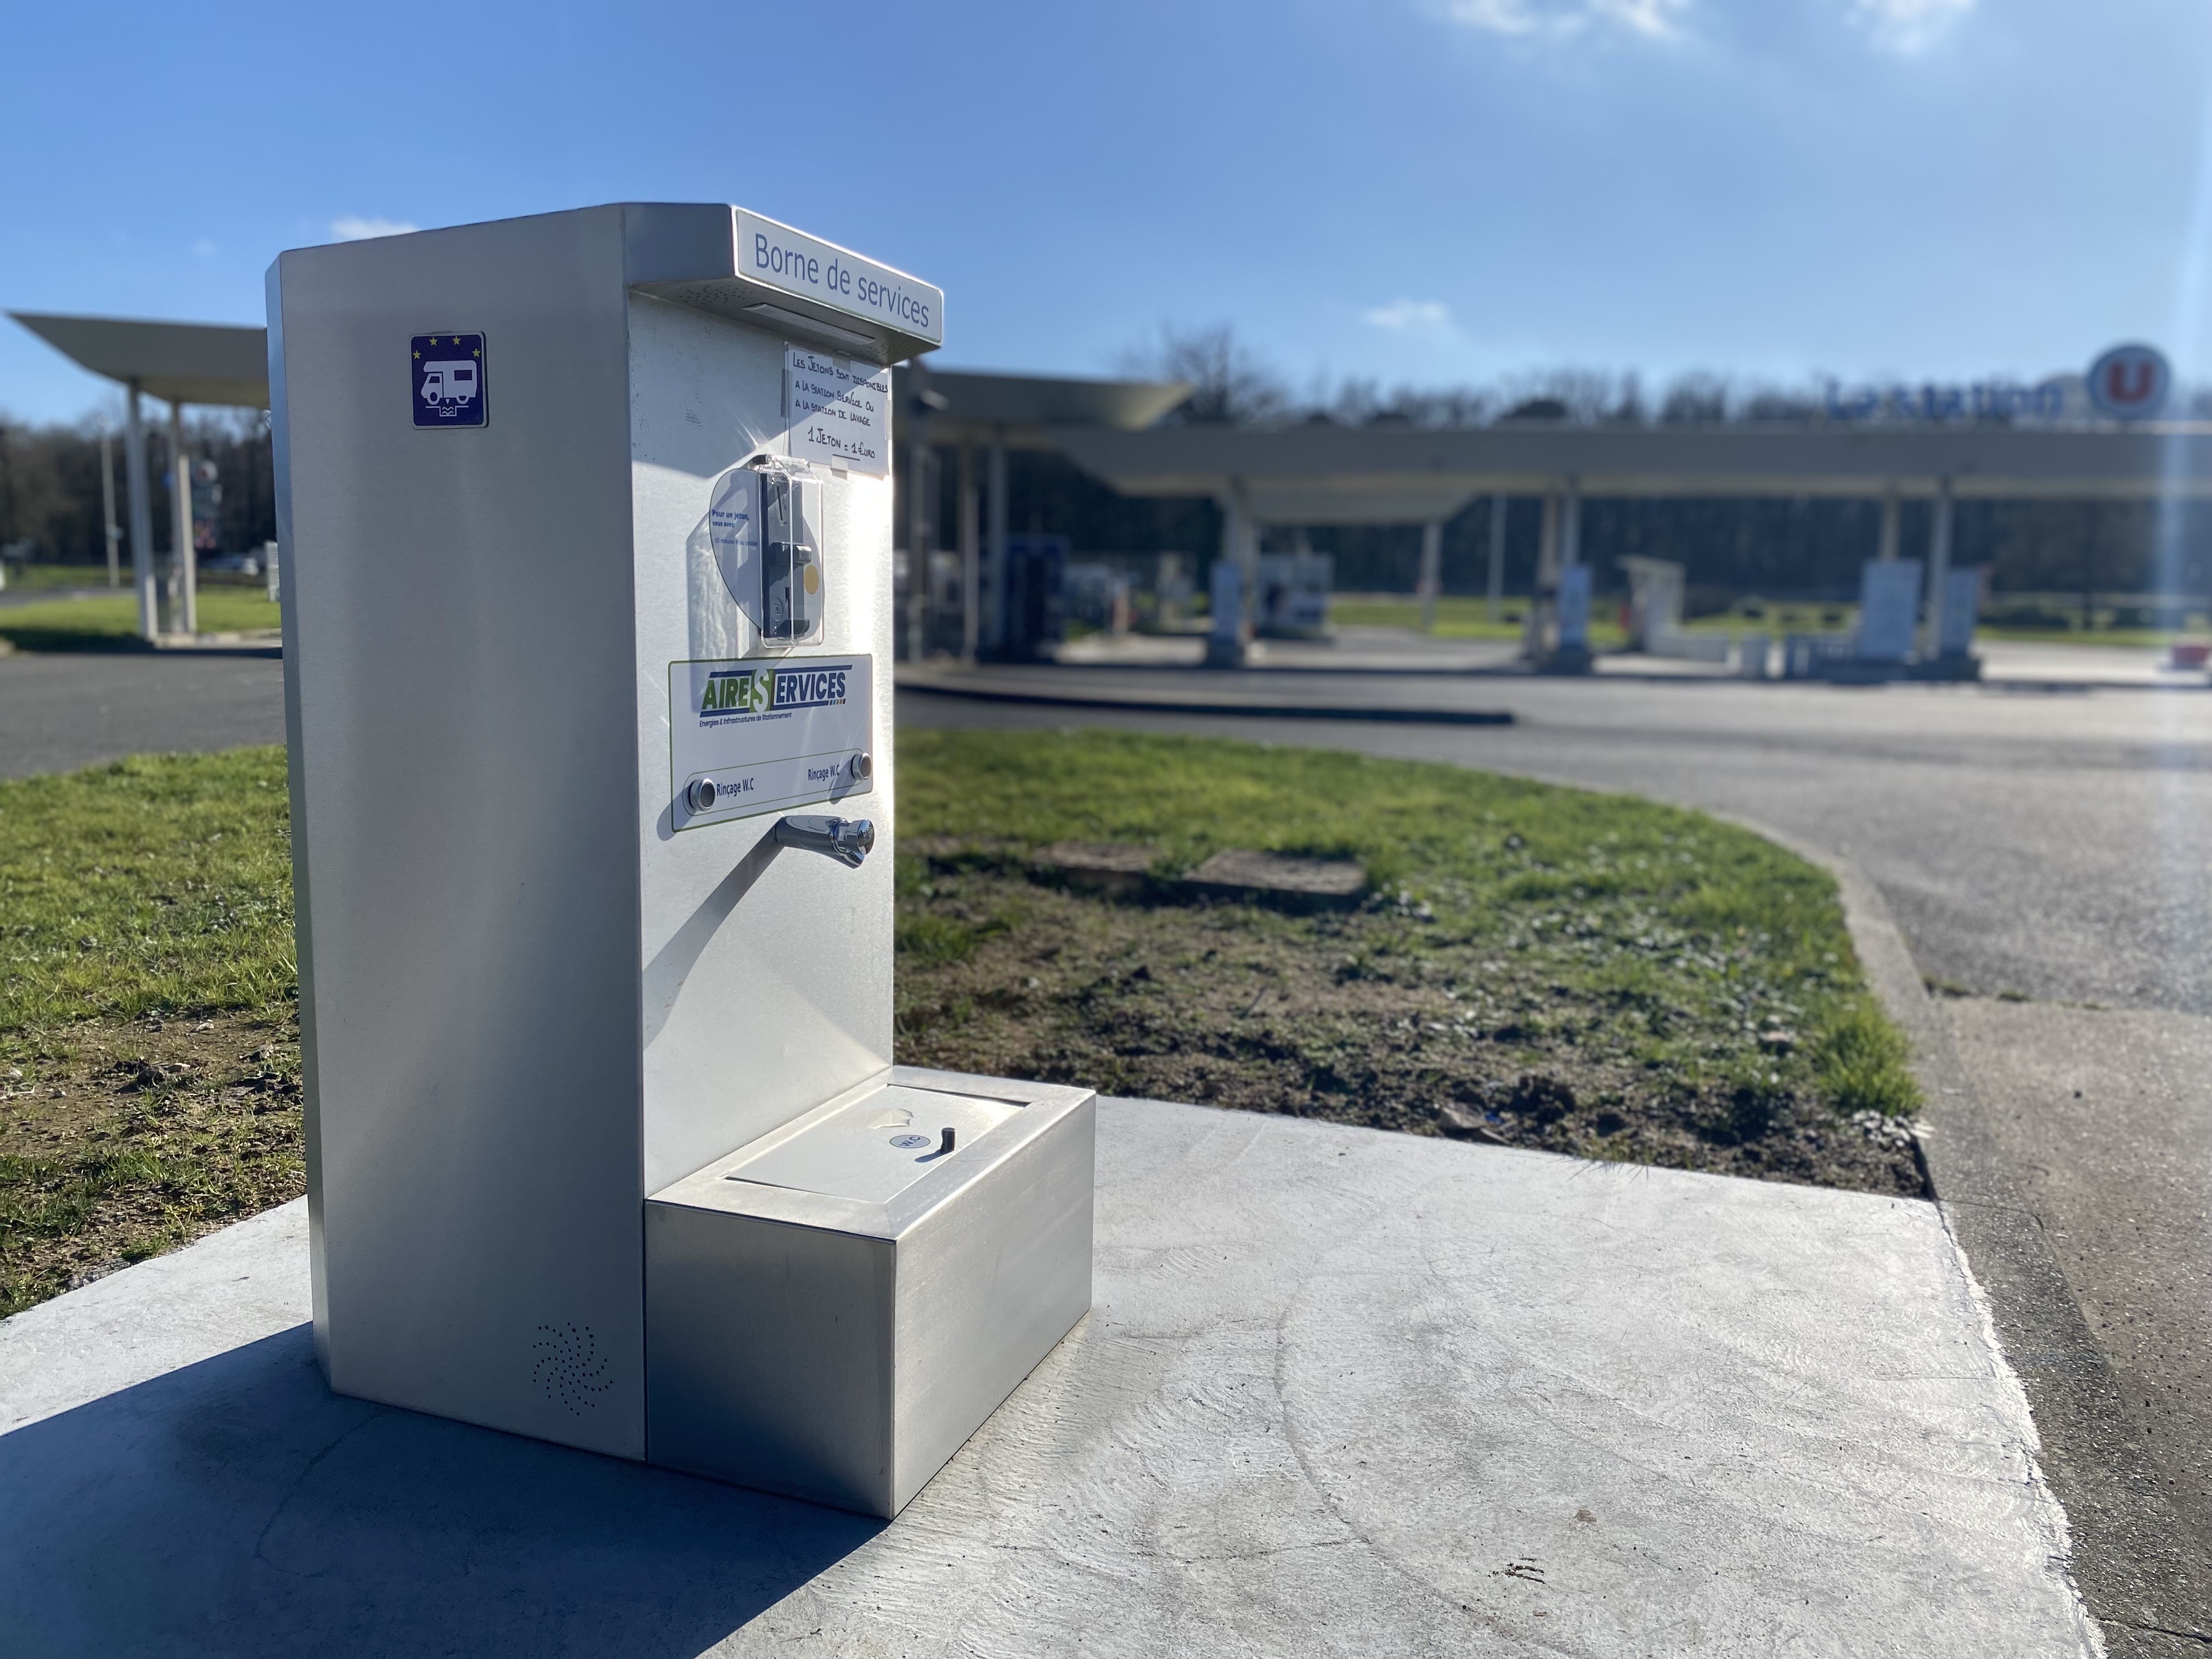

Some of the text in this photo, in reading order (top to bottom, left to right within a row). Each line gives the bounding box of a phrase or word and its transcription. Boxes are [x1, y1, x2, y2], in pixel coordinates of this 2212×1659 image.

[755, 233, 929, 328] Borne de services
[793, 352, 888, 393] LES JETONS SONT DISPONIBLES
[795, 380, 800, 390] A
[802, 380, 810, 392] LA
[811, 383, 834, 398] STATION
[837, 390, 862, 408] SERVICE
[795, 399, 871, 427] A LA STATION DE LAVAGE
[808, 425, 815, 442] 1
[816, 428, 841, 448] JETON
[851, 442, 857, 454] 1
[808, 768, 829, 782] Rinçage
[716, 782, 741, 797] Rinçage
